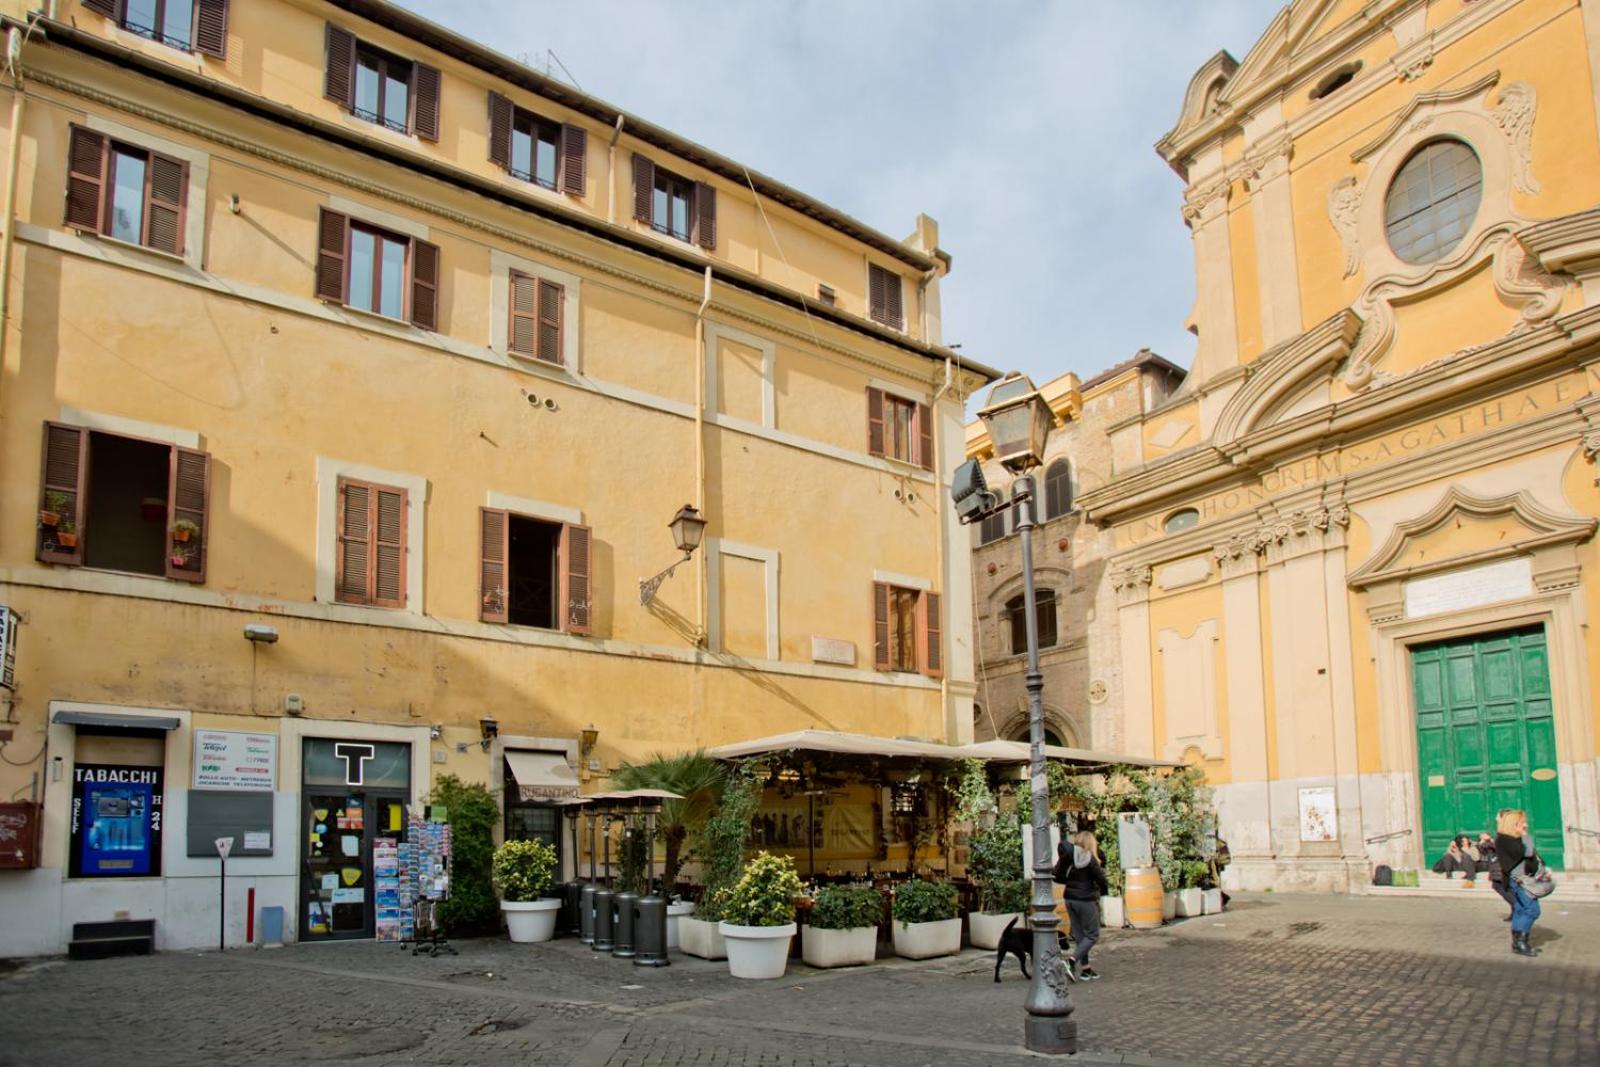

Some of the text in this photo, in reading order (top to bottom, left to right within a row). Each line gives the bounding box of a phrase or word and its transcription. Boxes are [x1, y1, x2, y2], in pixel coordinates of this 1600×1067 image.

[1202, 455, 1341, 518] HONOREM
[75, 768, 157, 784] TABACCHI
[335, 743, 375, 786] T
[72, 798, 82, 834] SELF
[151, 795, 162, 831] H 24
